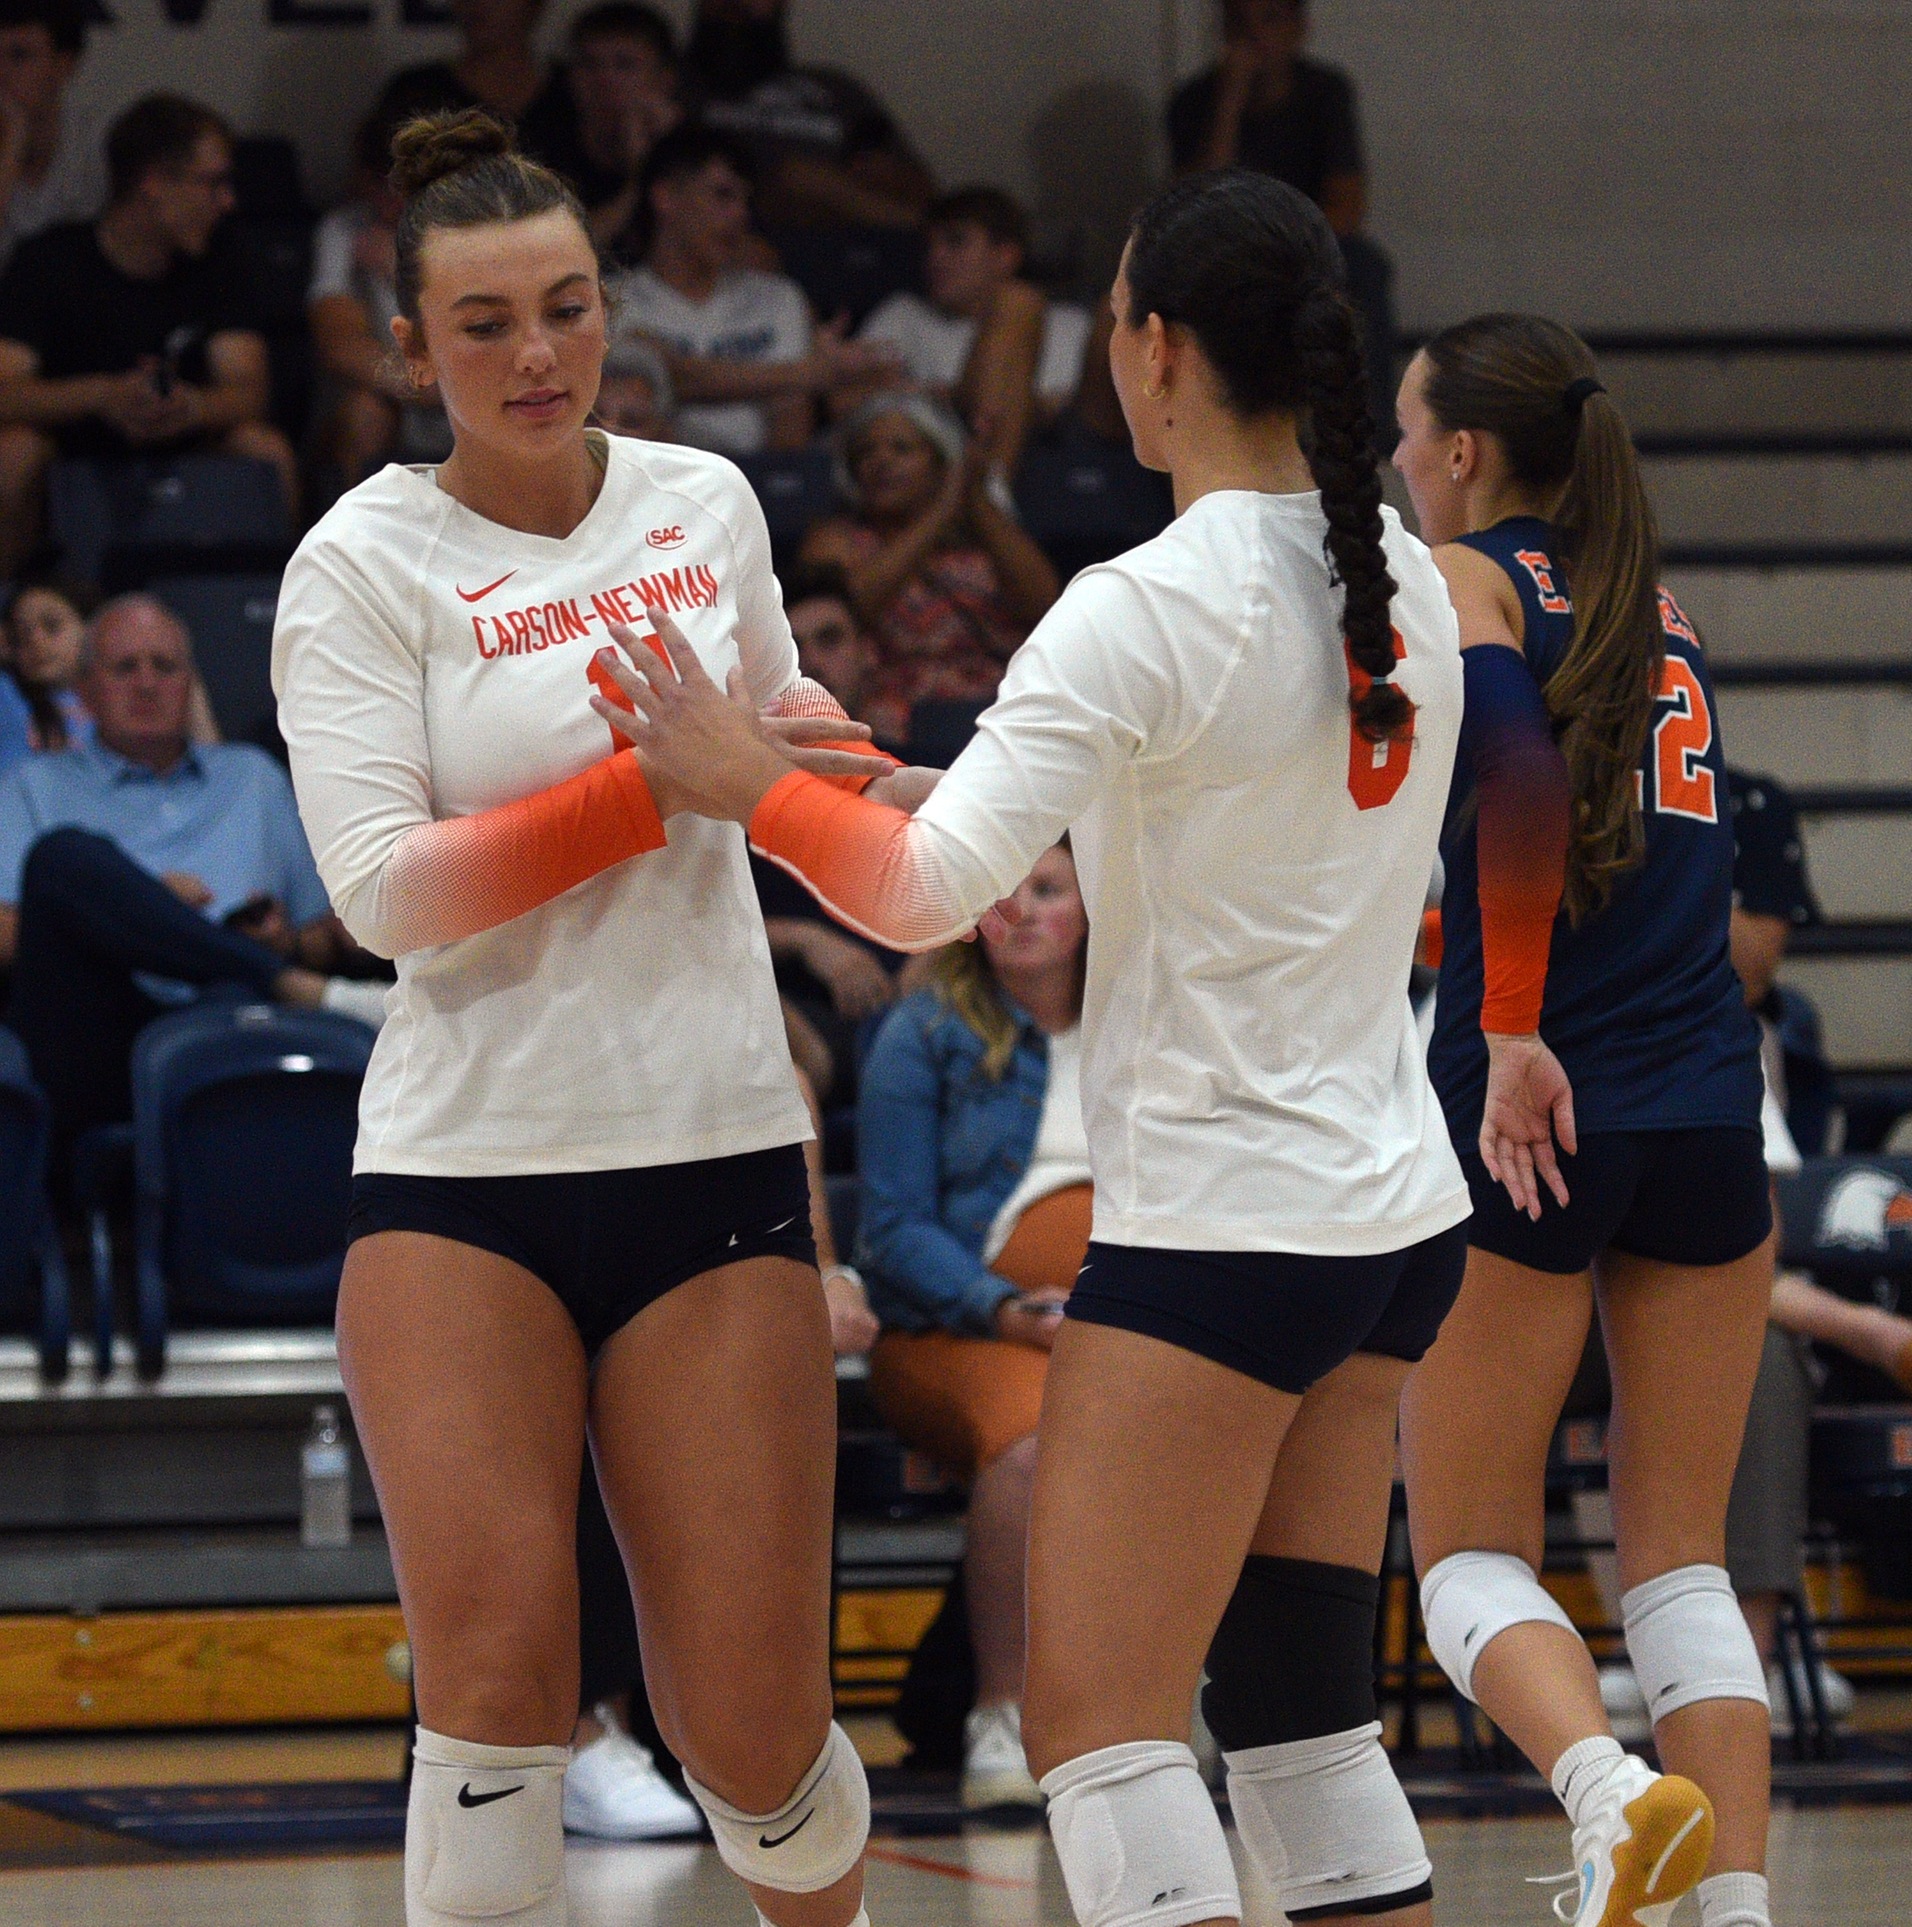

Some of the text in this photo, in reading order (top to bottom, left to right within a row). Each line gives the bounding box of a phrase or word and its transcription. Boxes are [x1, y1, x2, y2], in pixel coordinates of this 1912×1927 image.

[650, 525, 685, 544] SAC
[471, 563, 718, 660] CARSON-NEWMAN
[1634, 653, 1718, 824] 2
